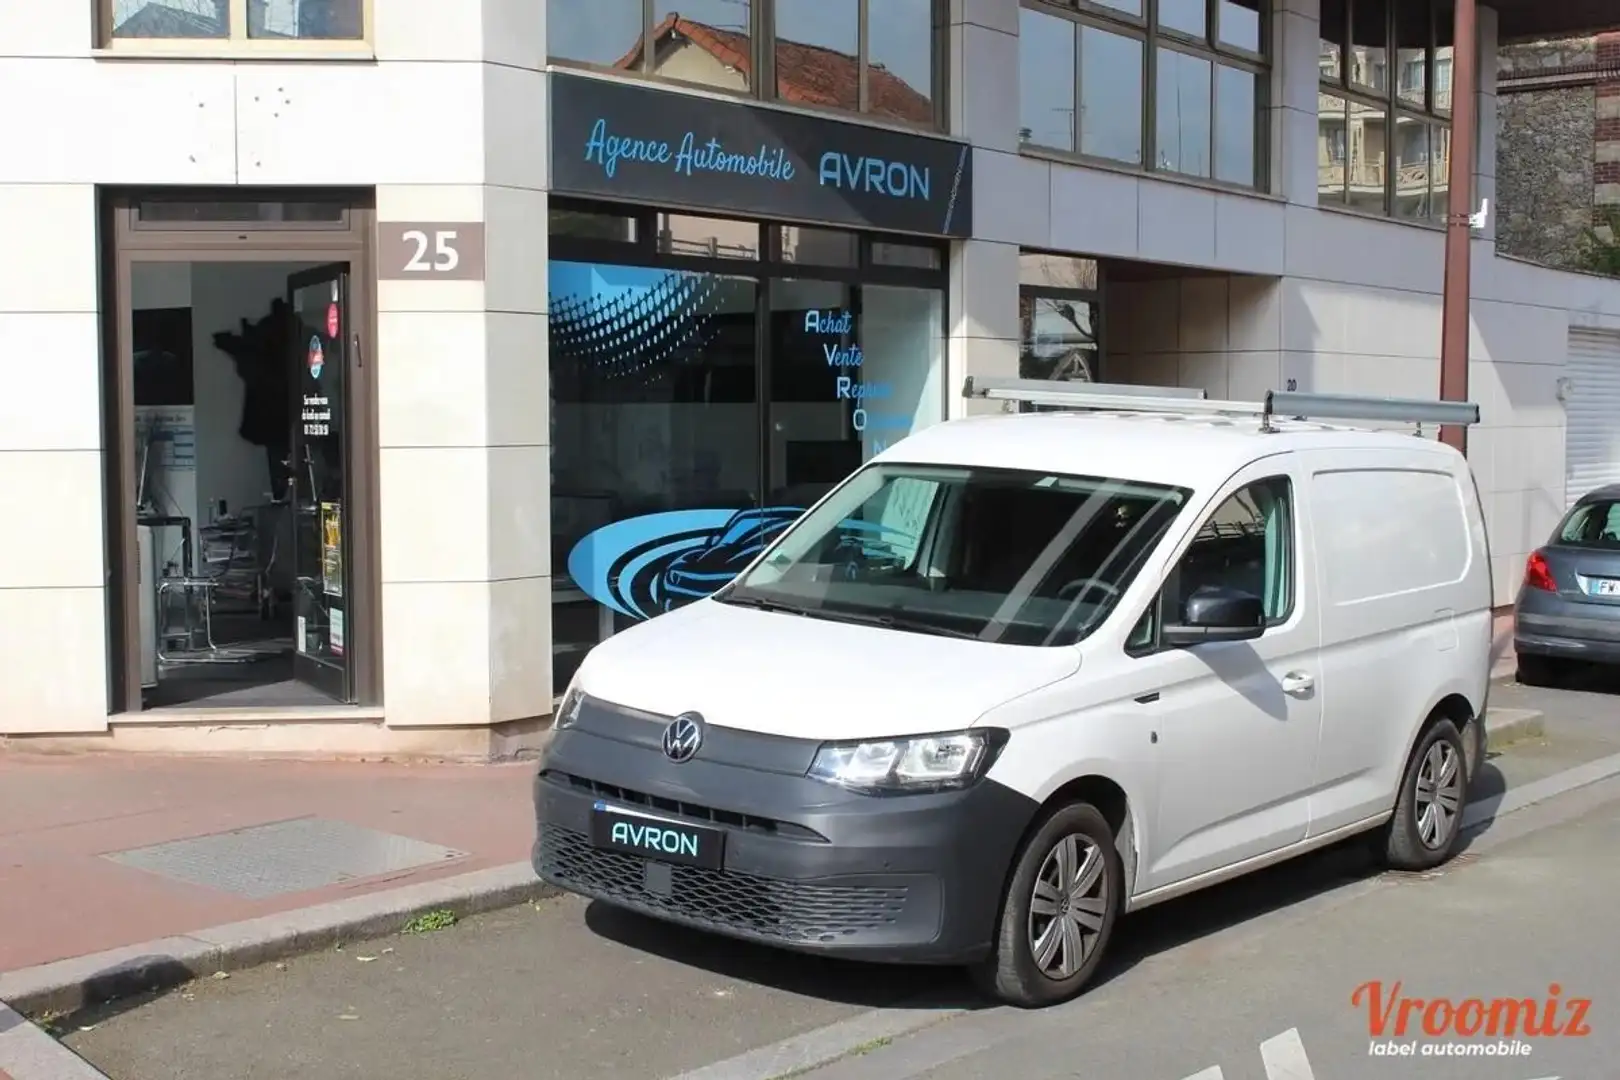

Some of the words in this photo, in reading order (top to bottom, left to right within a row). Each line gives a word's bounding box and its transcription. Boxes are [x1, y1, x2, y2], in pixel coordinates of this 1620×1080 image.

[585, 118, 672, 179] Agence
[674, 131, 796, 181] Automobile
[818, 151, 931, 200] AVRON
[402, 230, 459, 271] 25
[804, 310, 852, 334] Achat
[823, 343, 864, 367] Vente
[611, 822, 698, 857] AVRON
